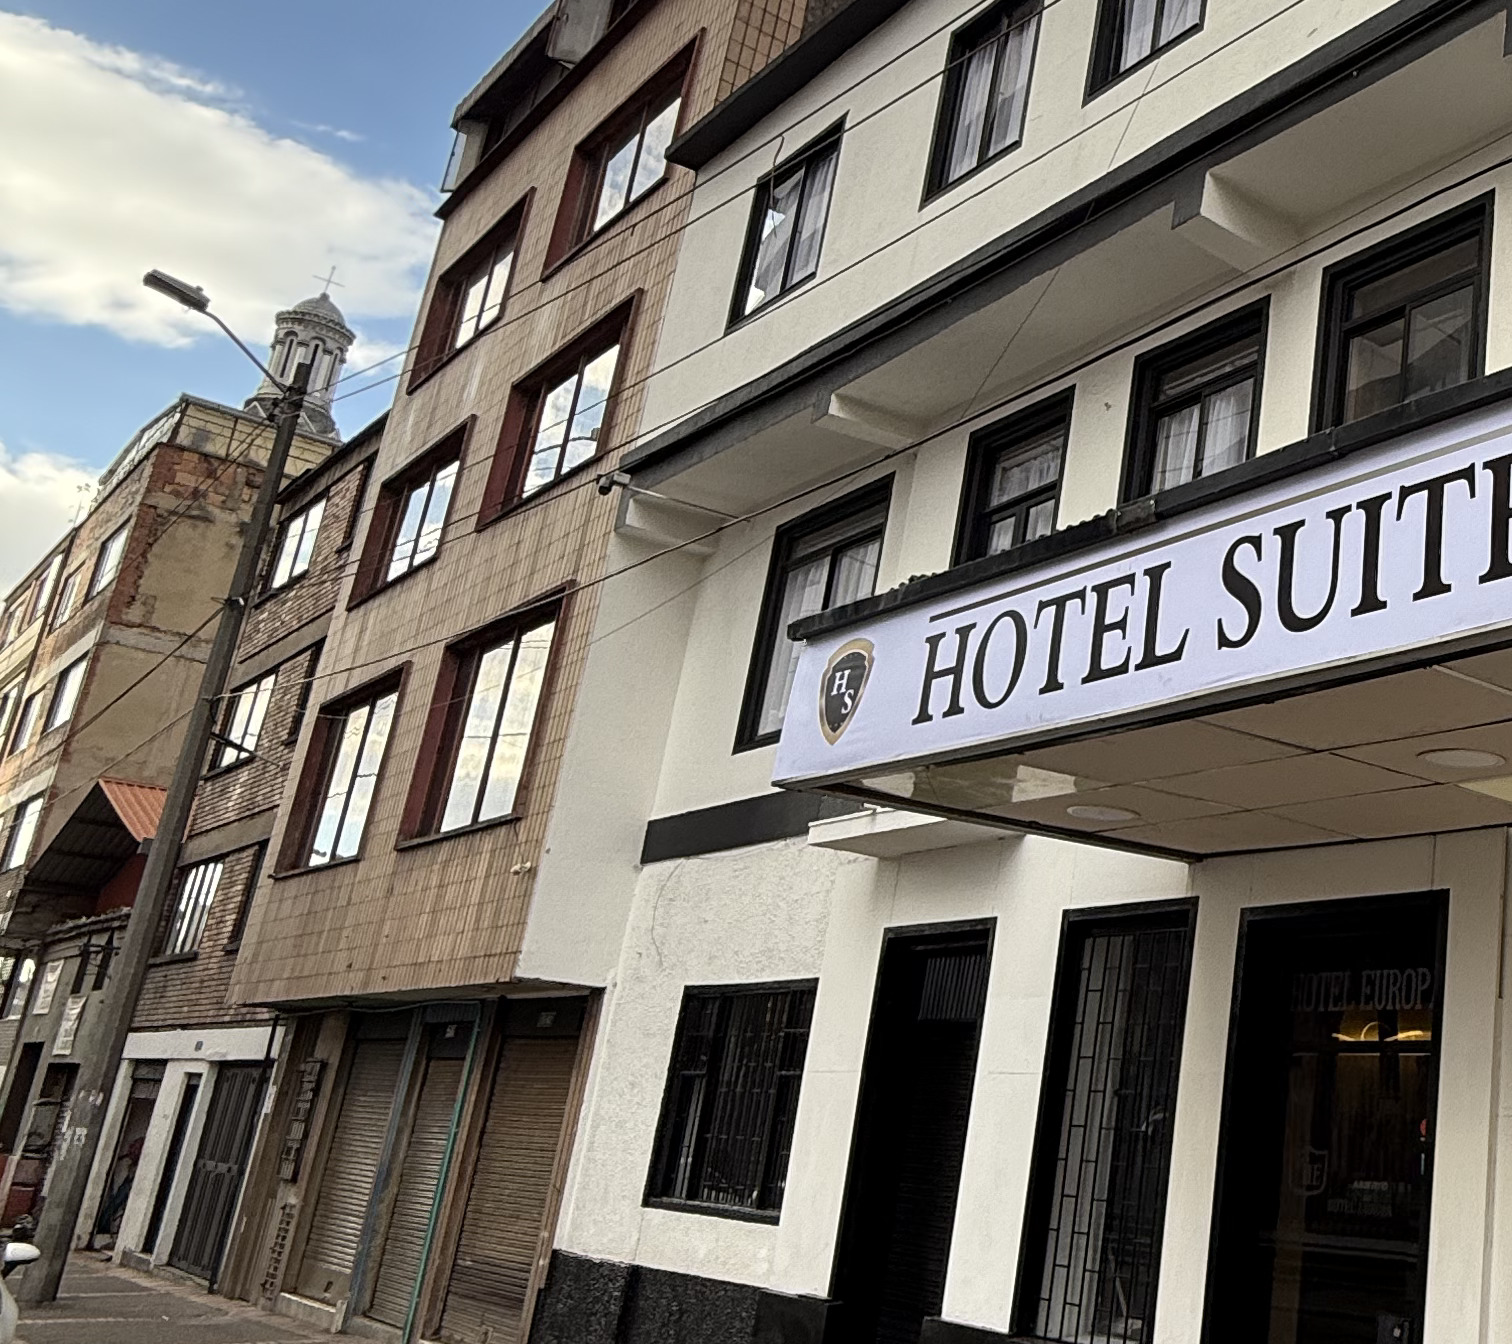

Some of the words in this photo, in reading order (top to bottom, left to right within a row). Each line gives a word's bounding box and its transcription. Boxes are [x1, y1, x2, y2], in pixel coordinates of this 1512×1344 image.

[910, 560, 1190, 726] HOTEL
[1289, 967, 1352, 1012] HOTEL
[1360, 967, 1436, 1010] EUROP
